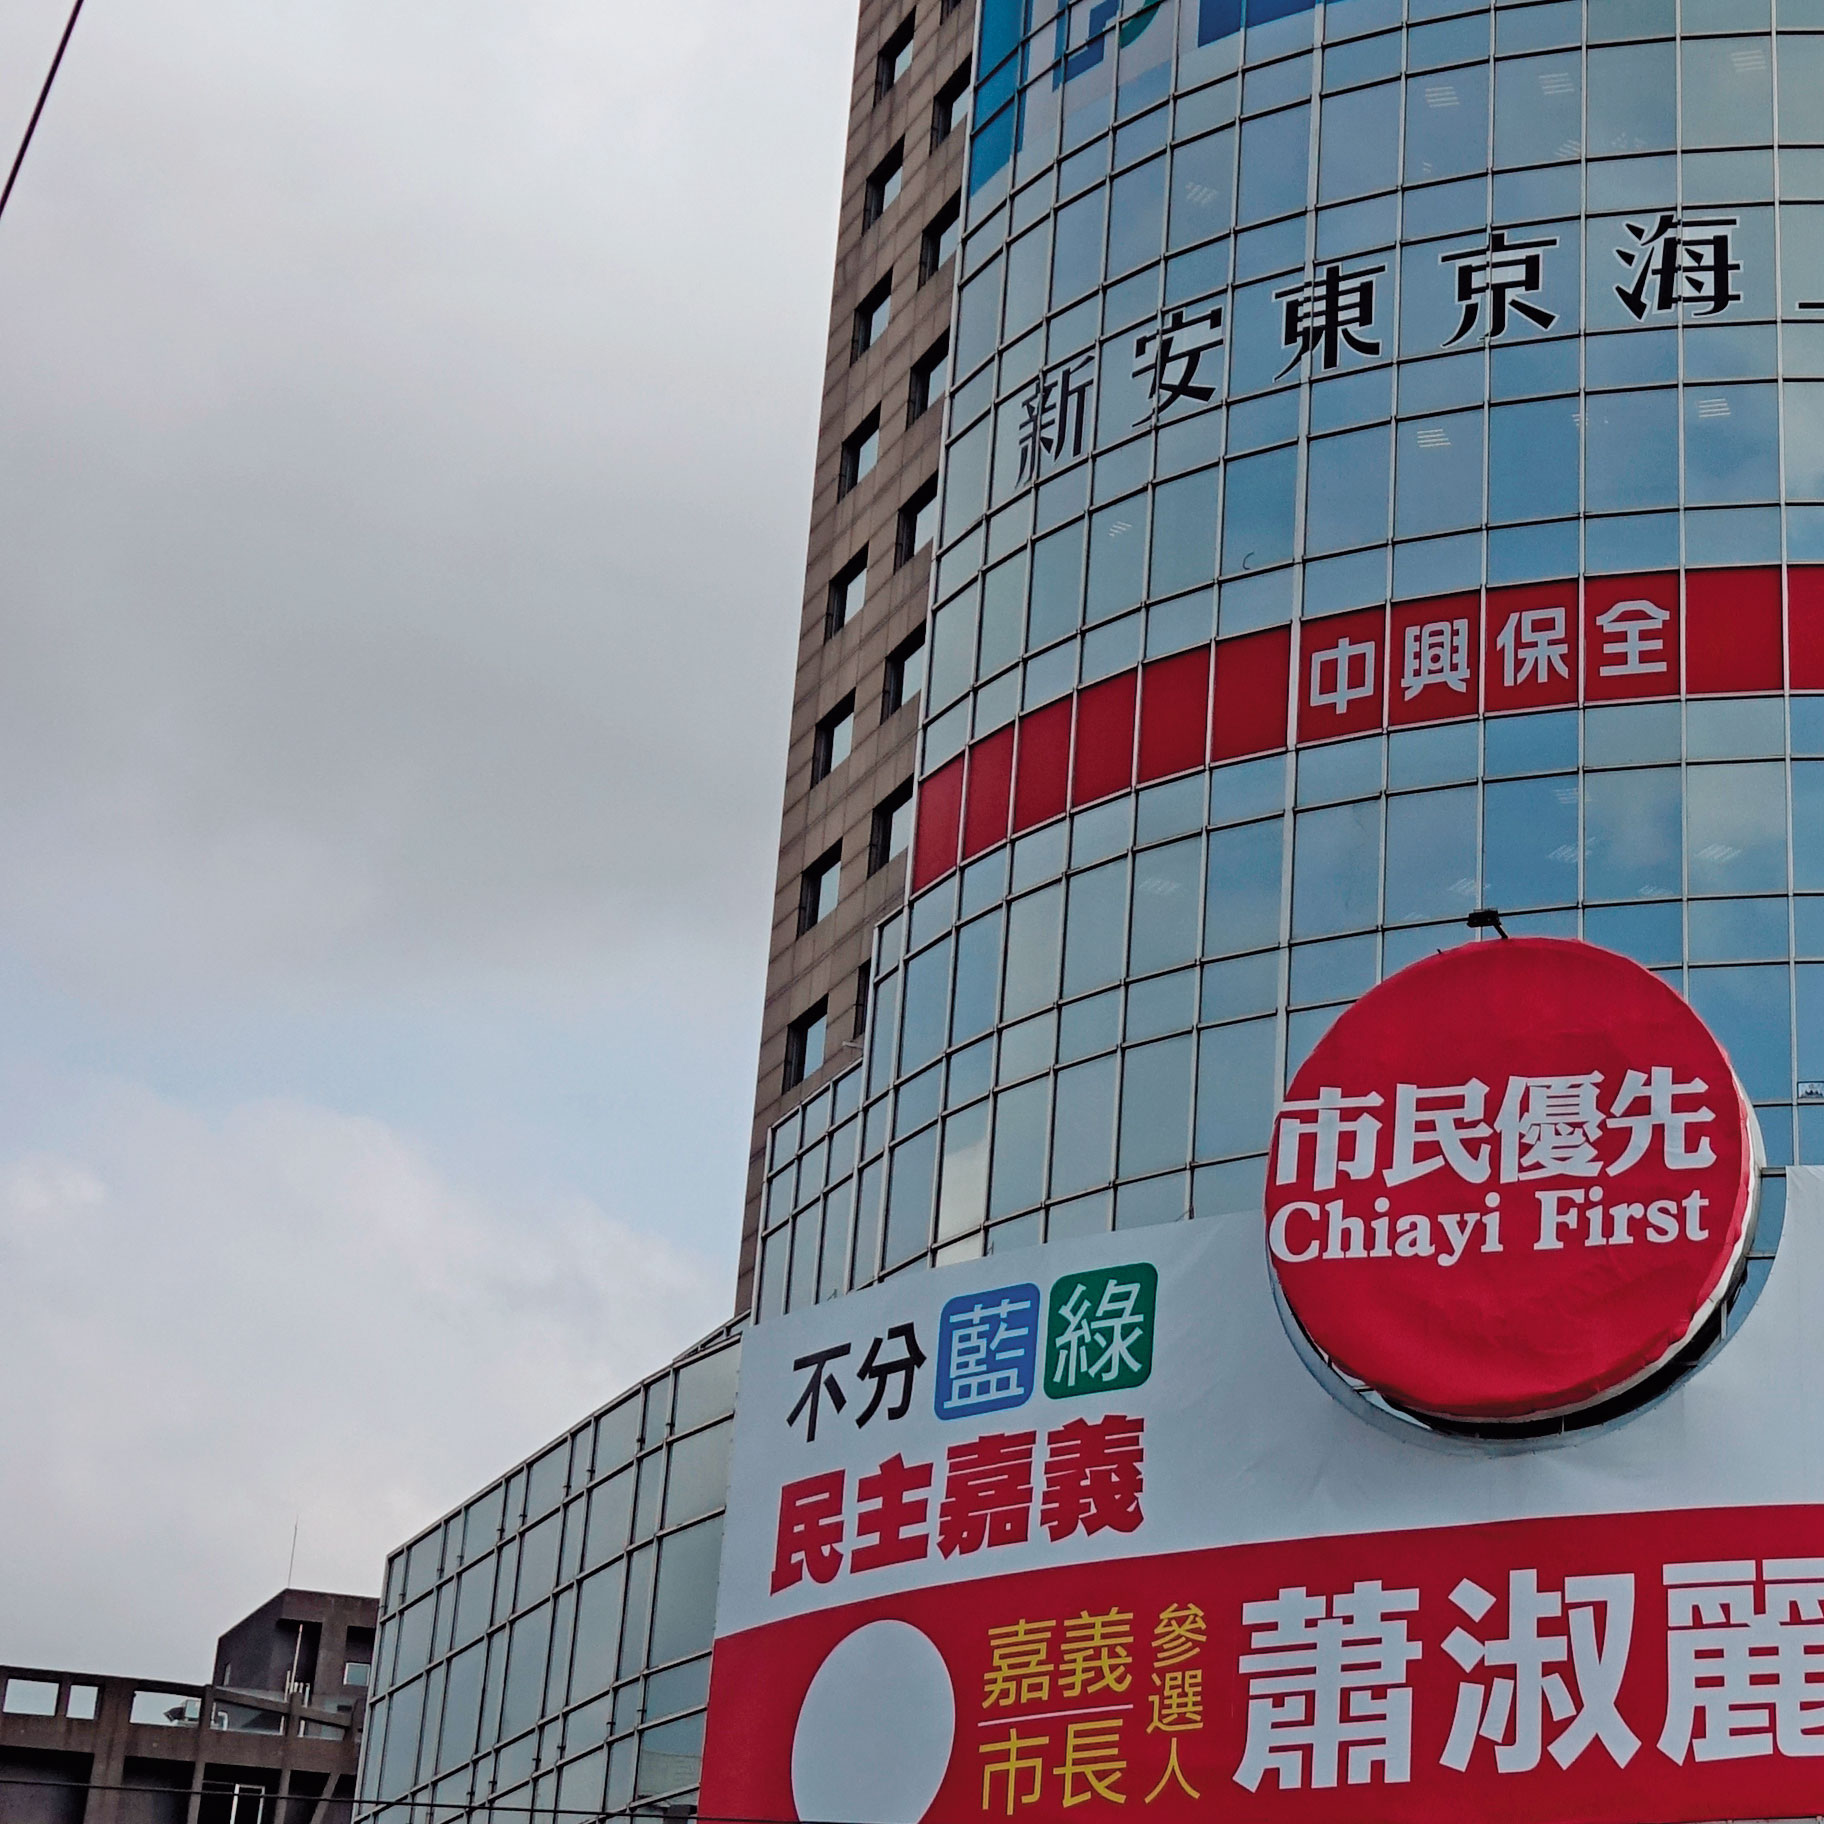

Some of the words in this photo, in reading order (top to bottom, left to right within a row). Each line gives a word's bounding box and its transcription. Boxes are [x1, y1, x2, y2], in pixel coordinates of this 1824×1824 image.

[1309, 596, 1671, 716] 中興保全
[1276, 1065, 1718, 1192] 市民優先
[1267, 1193, 1504, 1268] Chiayi
[1534, 1186, 1709, 1251] First
[786, 1278, 1146, 1443] 不分藍綠
[769, 1415, 1146, 1596] 民主嘉義
[982, 1607, 1134, 1714] 嘉義
[1143, 1601, 1205, 1804] 參選人
[978, 1717, 1127, 1818] 市長
